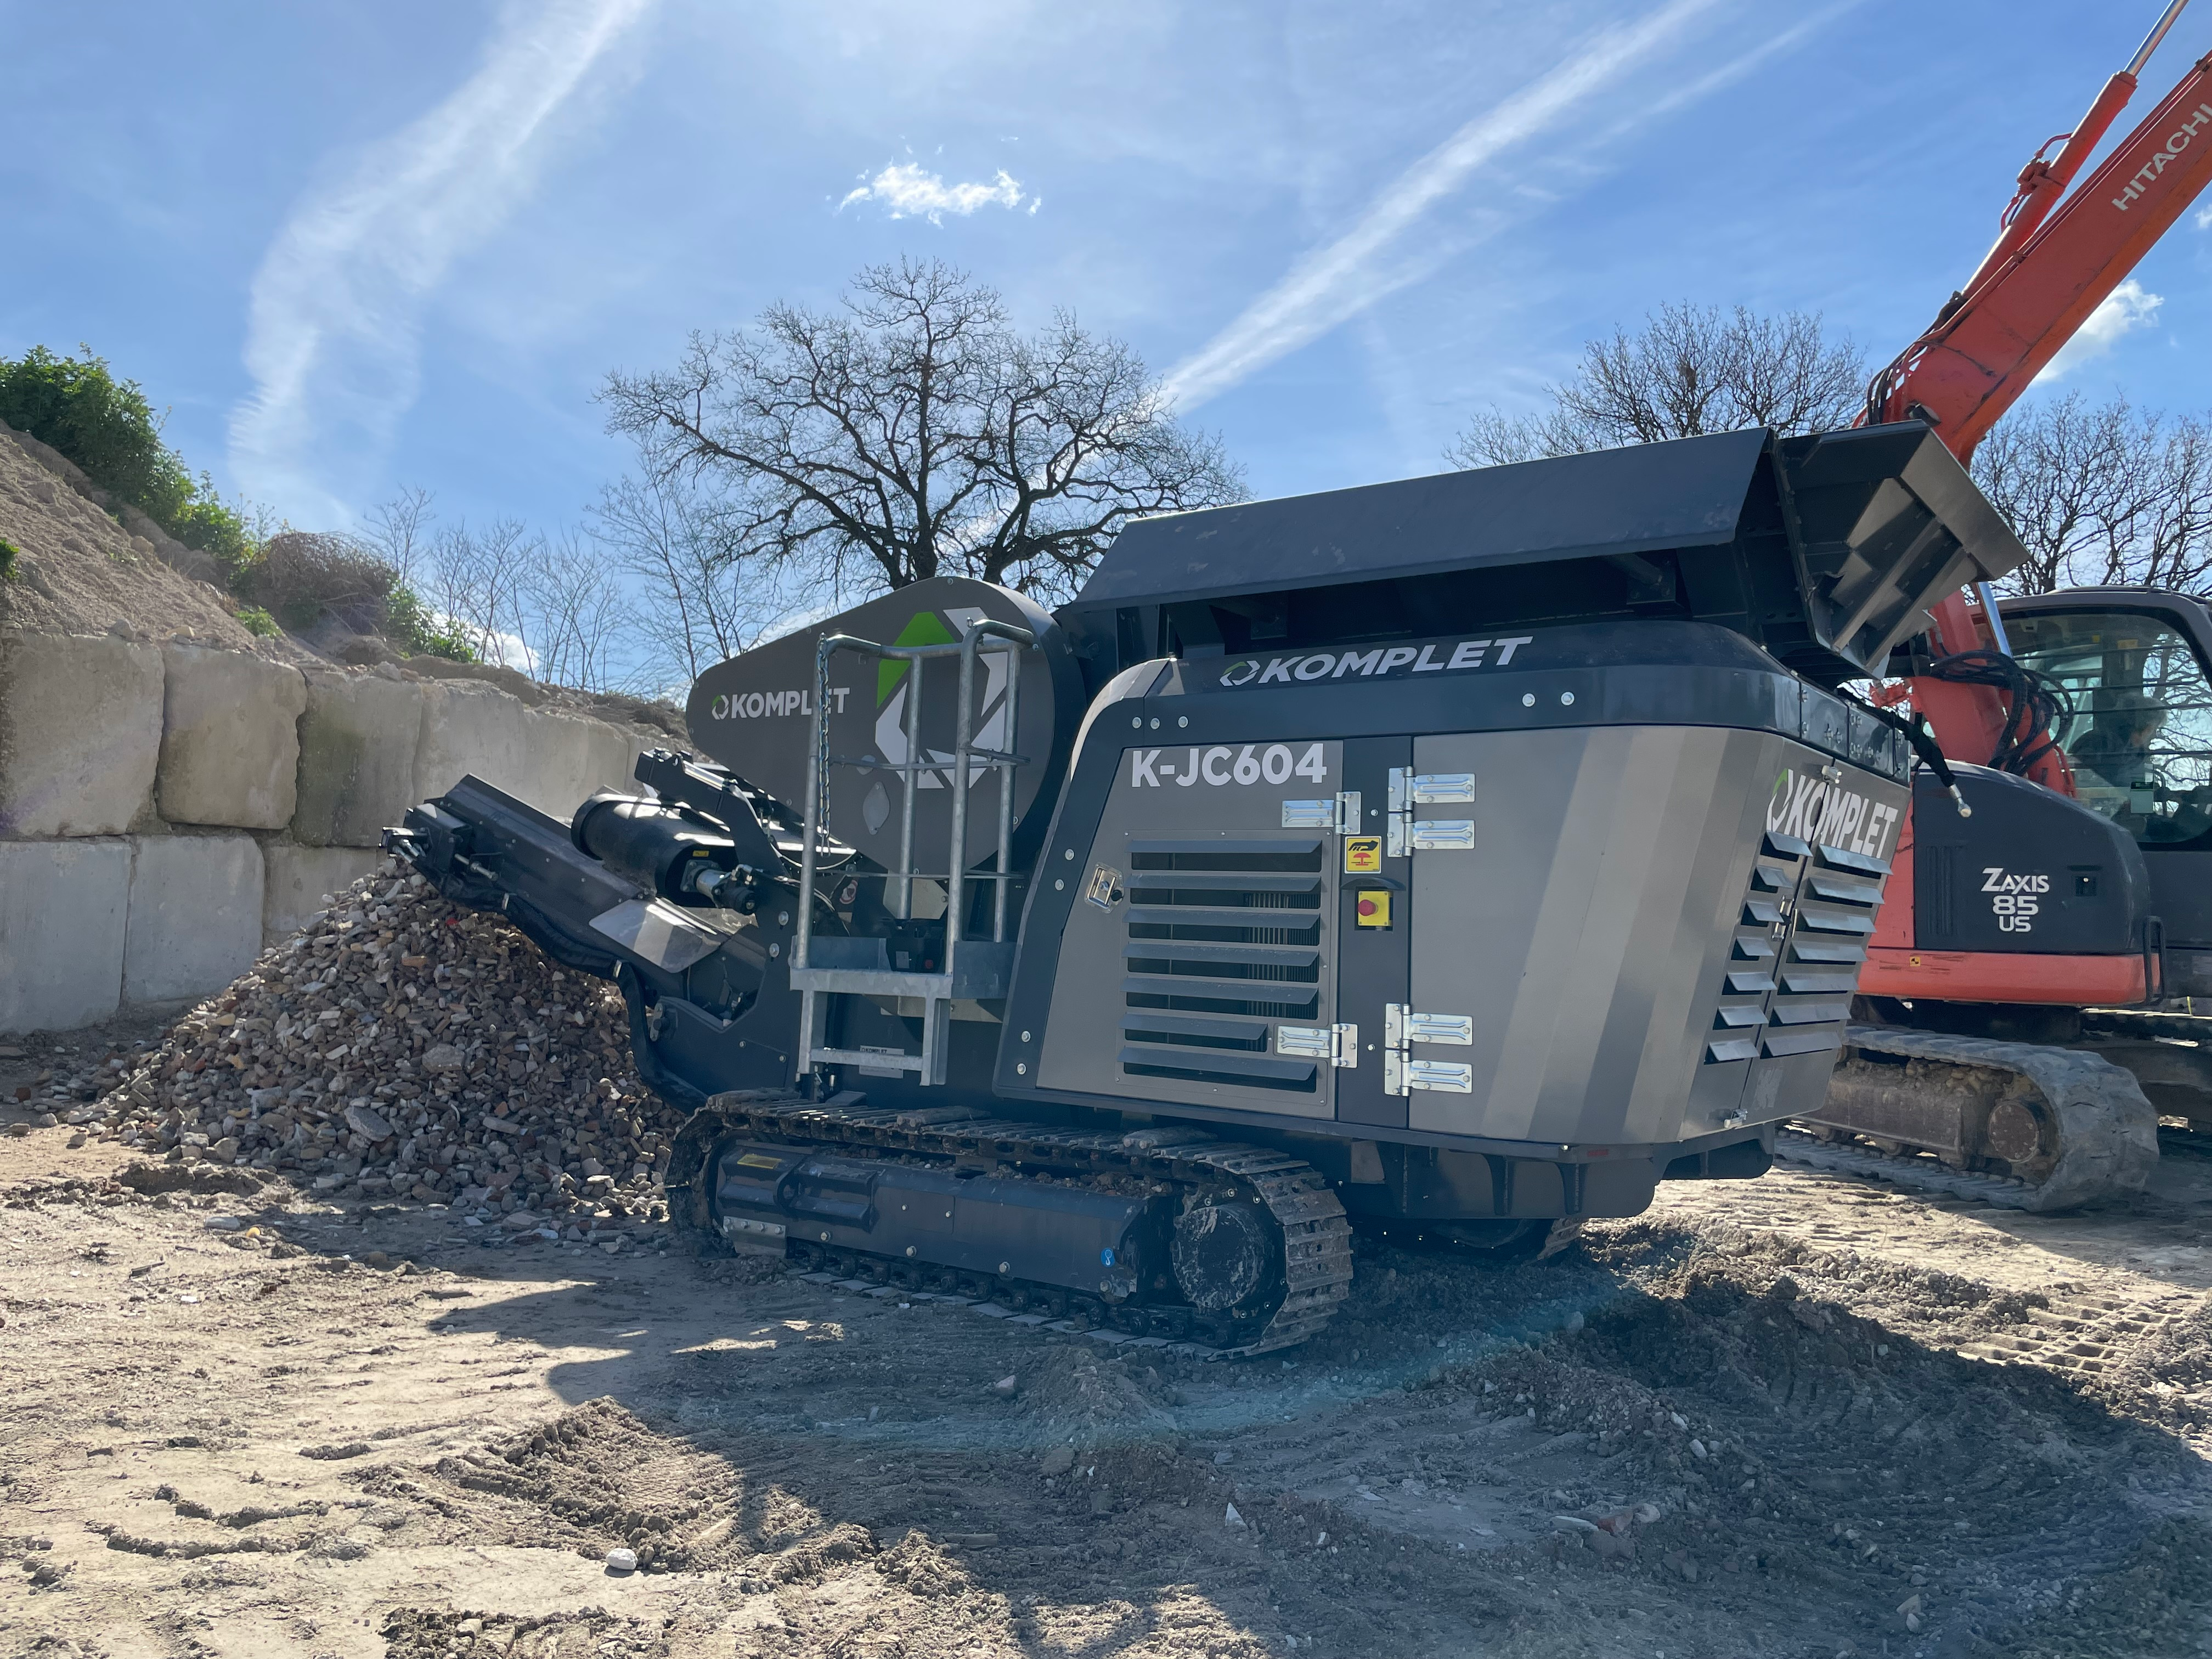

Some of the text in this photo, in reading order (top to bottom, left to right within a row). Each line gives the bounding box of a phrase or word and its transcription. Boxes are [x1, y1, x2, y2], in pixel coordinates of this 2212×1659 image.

[2112, 103, 2212, 211] HITACHI
[1257, 636, 1534, 684] KOMPLET
[1131, 743, 1327, 788] K-JC604
[1784, 774, 1899, 859] KOMPLET
[1980, 867, 2050, 895] ZAXIS
[1992, 895, 2039, 915] 85
[1999, 916, 2032, 932] US
